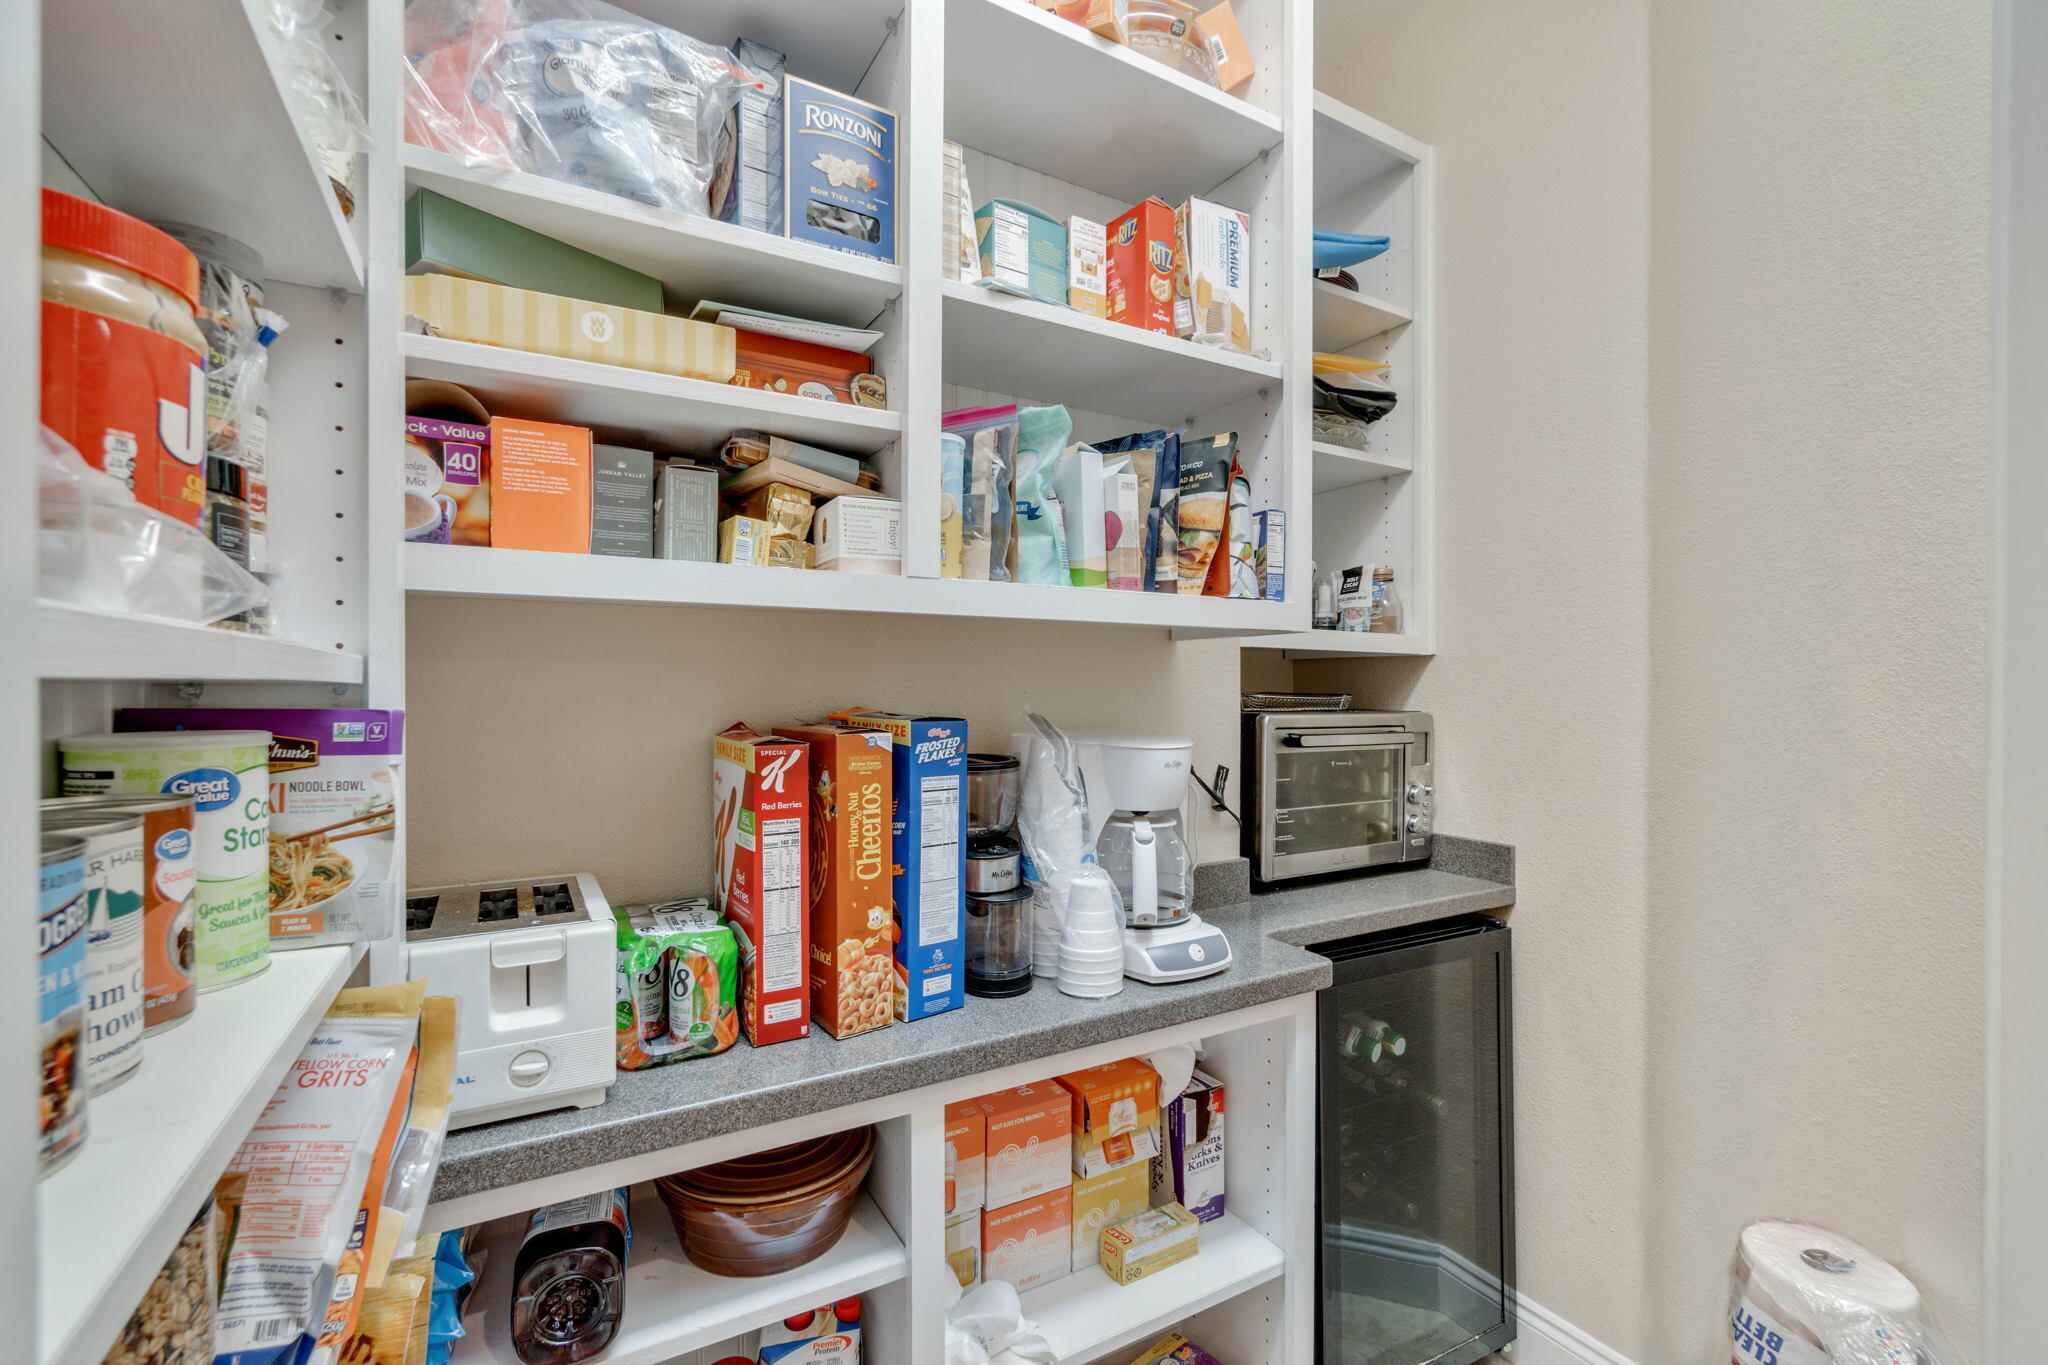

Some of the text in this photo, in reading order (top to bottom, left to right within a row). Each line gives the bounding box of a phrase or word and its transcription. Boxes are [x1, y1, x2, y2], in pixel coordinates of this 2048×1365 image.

[805, 104, 882, 149] RONZONI
[1119, 217, 1138, 244] RITZ
[1149, 240, 1174, 271] RITZ
[1229, 220, 1239, 289] PREMIUM
[440, 424, 486, 441] Value
[447, 452, 476, 472] 40
[406, 476, 428, 487] Mix
[447, 470, 477, 478] ENVELOPES
[598, 469, 621, 477] JORDAN
[1195, 471, 1213, 481] PIZZA
[888, 519, 899, 550] Enjoy!
[885, 723, 907, 738] SIZE
[716, 741, 746, 763] FAMILY SIZE
[914, 737, 960, 755] FROSTED
[917, 747, 957, 764] FLAKES
[761, 749, 802, 794] K
[170, 777, 231, 794] Great
[289, 780, 367, 793] NOODLE BOWL
[761, 801, 803, 811] Red Berries
[848, 791, 859, 811] Nut
[849, 810, 862, 848] Honey
[856, 782, 882, 880] Cheerios
[163, 835, 189, 849] Great
[735, 868, 745, 886] Red
[733, 882, 749, 905] Berries
[198, 896, 252, 919] Great for
[208, 915, 251, 932] Sauces
[670, 956, 690, 998] V8
[347, 1059, 388, 1069] CORN
[297, 1069, 368, 1089] GRITS
[991, 1123, 1003, 1131] NOT
[1003, 1120, 1014, 1129] JUST
[1014, 1118, 1025, 1126] FOR
[259, 1143, 291, 1151] Servings
[313, 1143, 345, 1151] Servings
[1191, 1142, 1223, 1161] orks &
[1188, 1153, 1221, 1172] Knives
[1021, 1181, 1044, 1194] Bellini
[1019, 1272, 1041, 1286] Bellini
[812, 1339, 843, 1351] Premier
[814, 1346, 841, 1356] Protein
